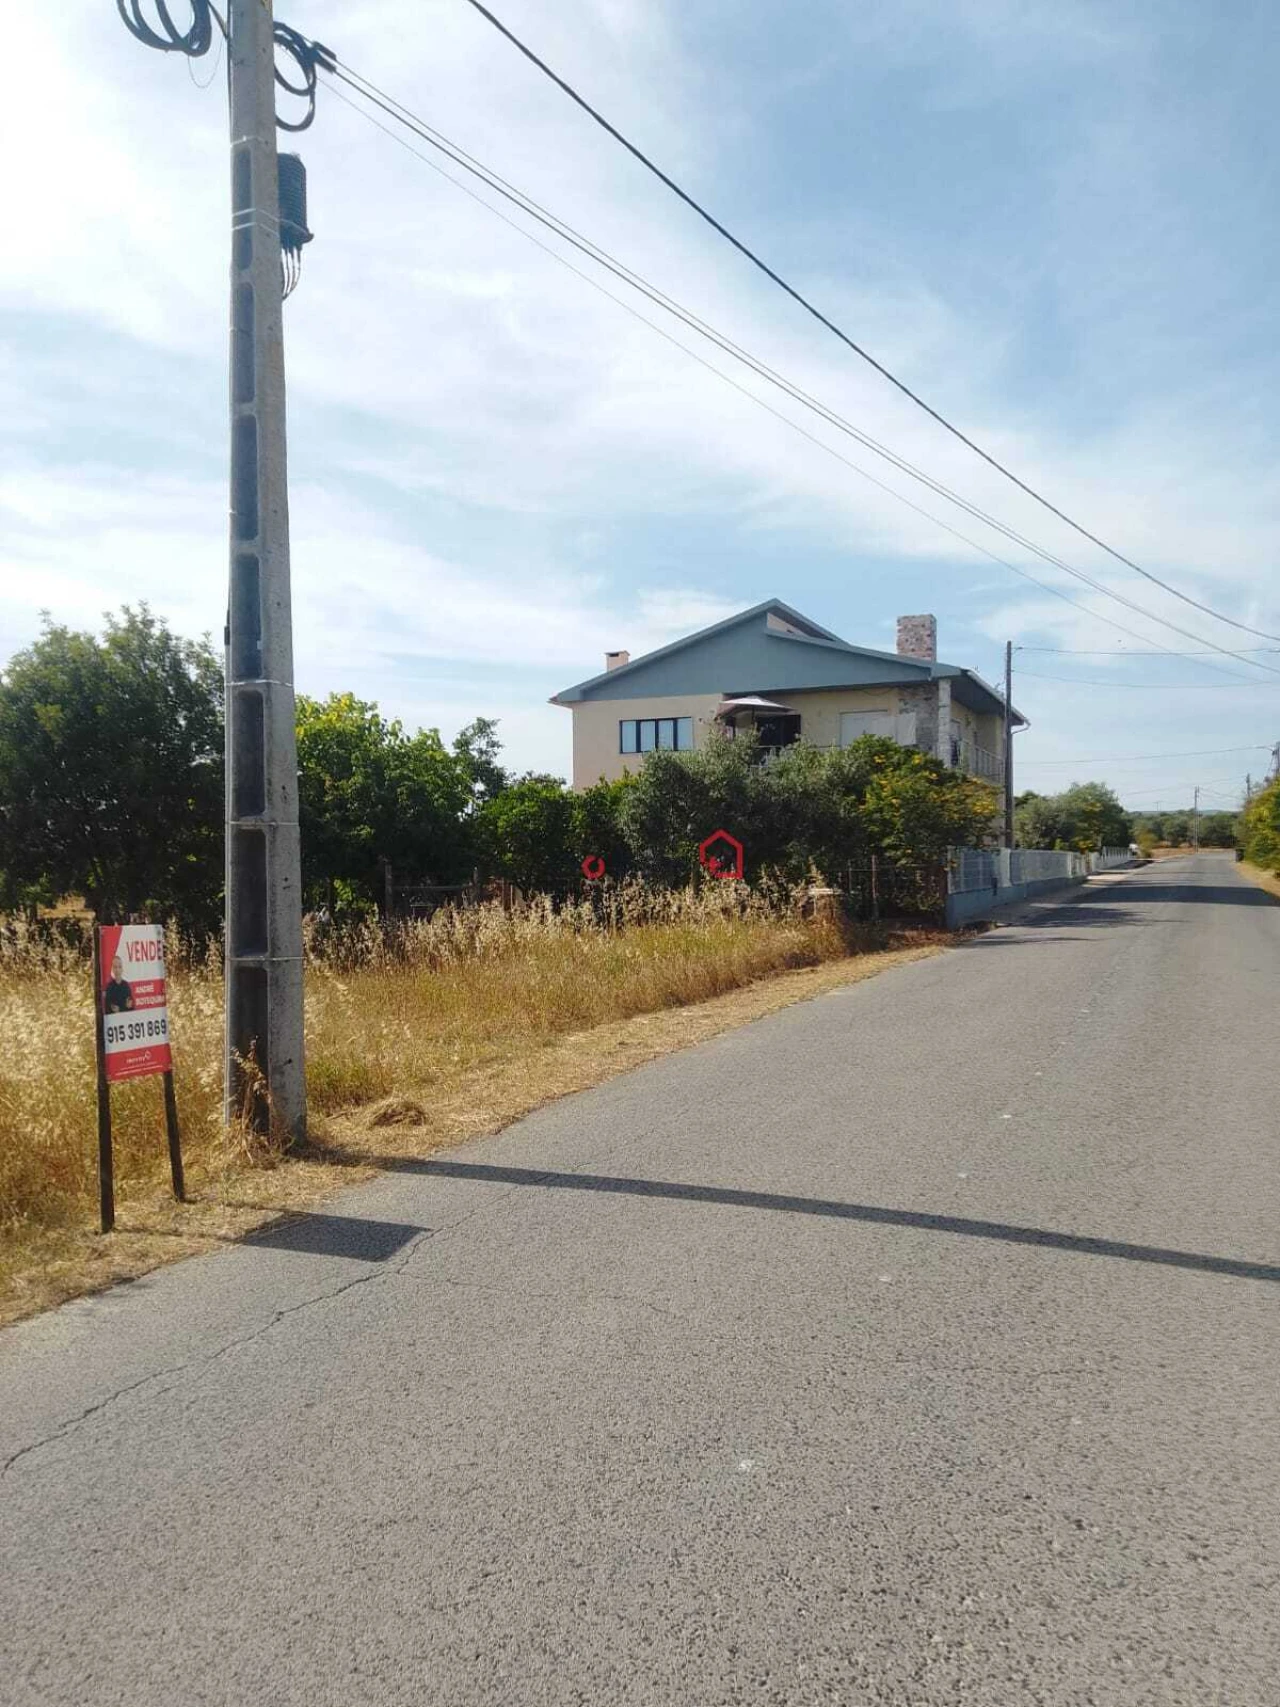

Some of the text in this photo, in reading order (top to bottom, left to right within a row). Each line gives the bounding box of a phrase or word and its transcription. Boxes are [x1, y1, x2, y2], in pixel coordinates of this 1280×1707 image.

[126, 940, 162, 962] VENDE
[107, 1019, 167, 1043] 915 391 869
